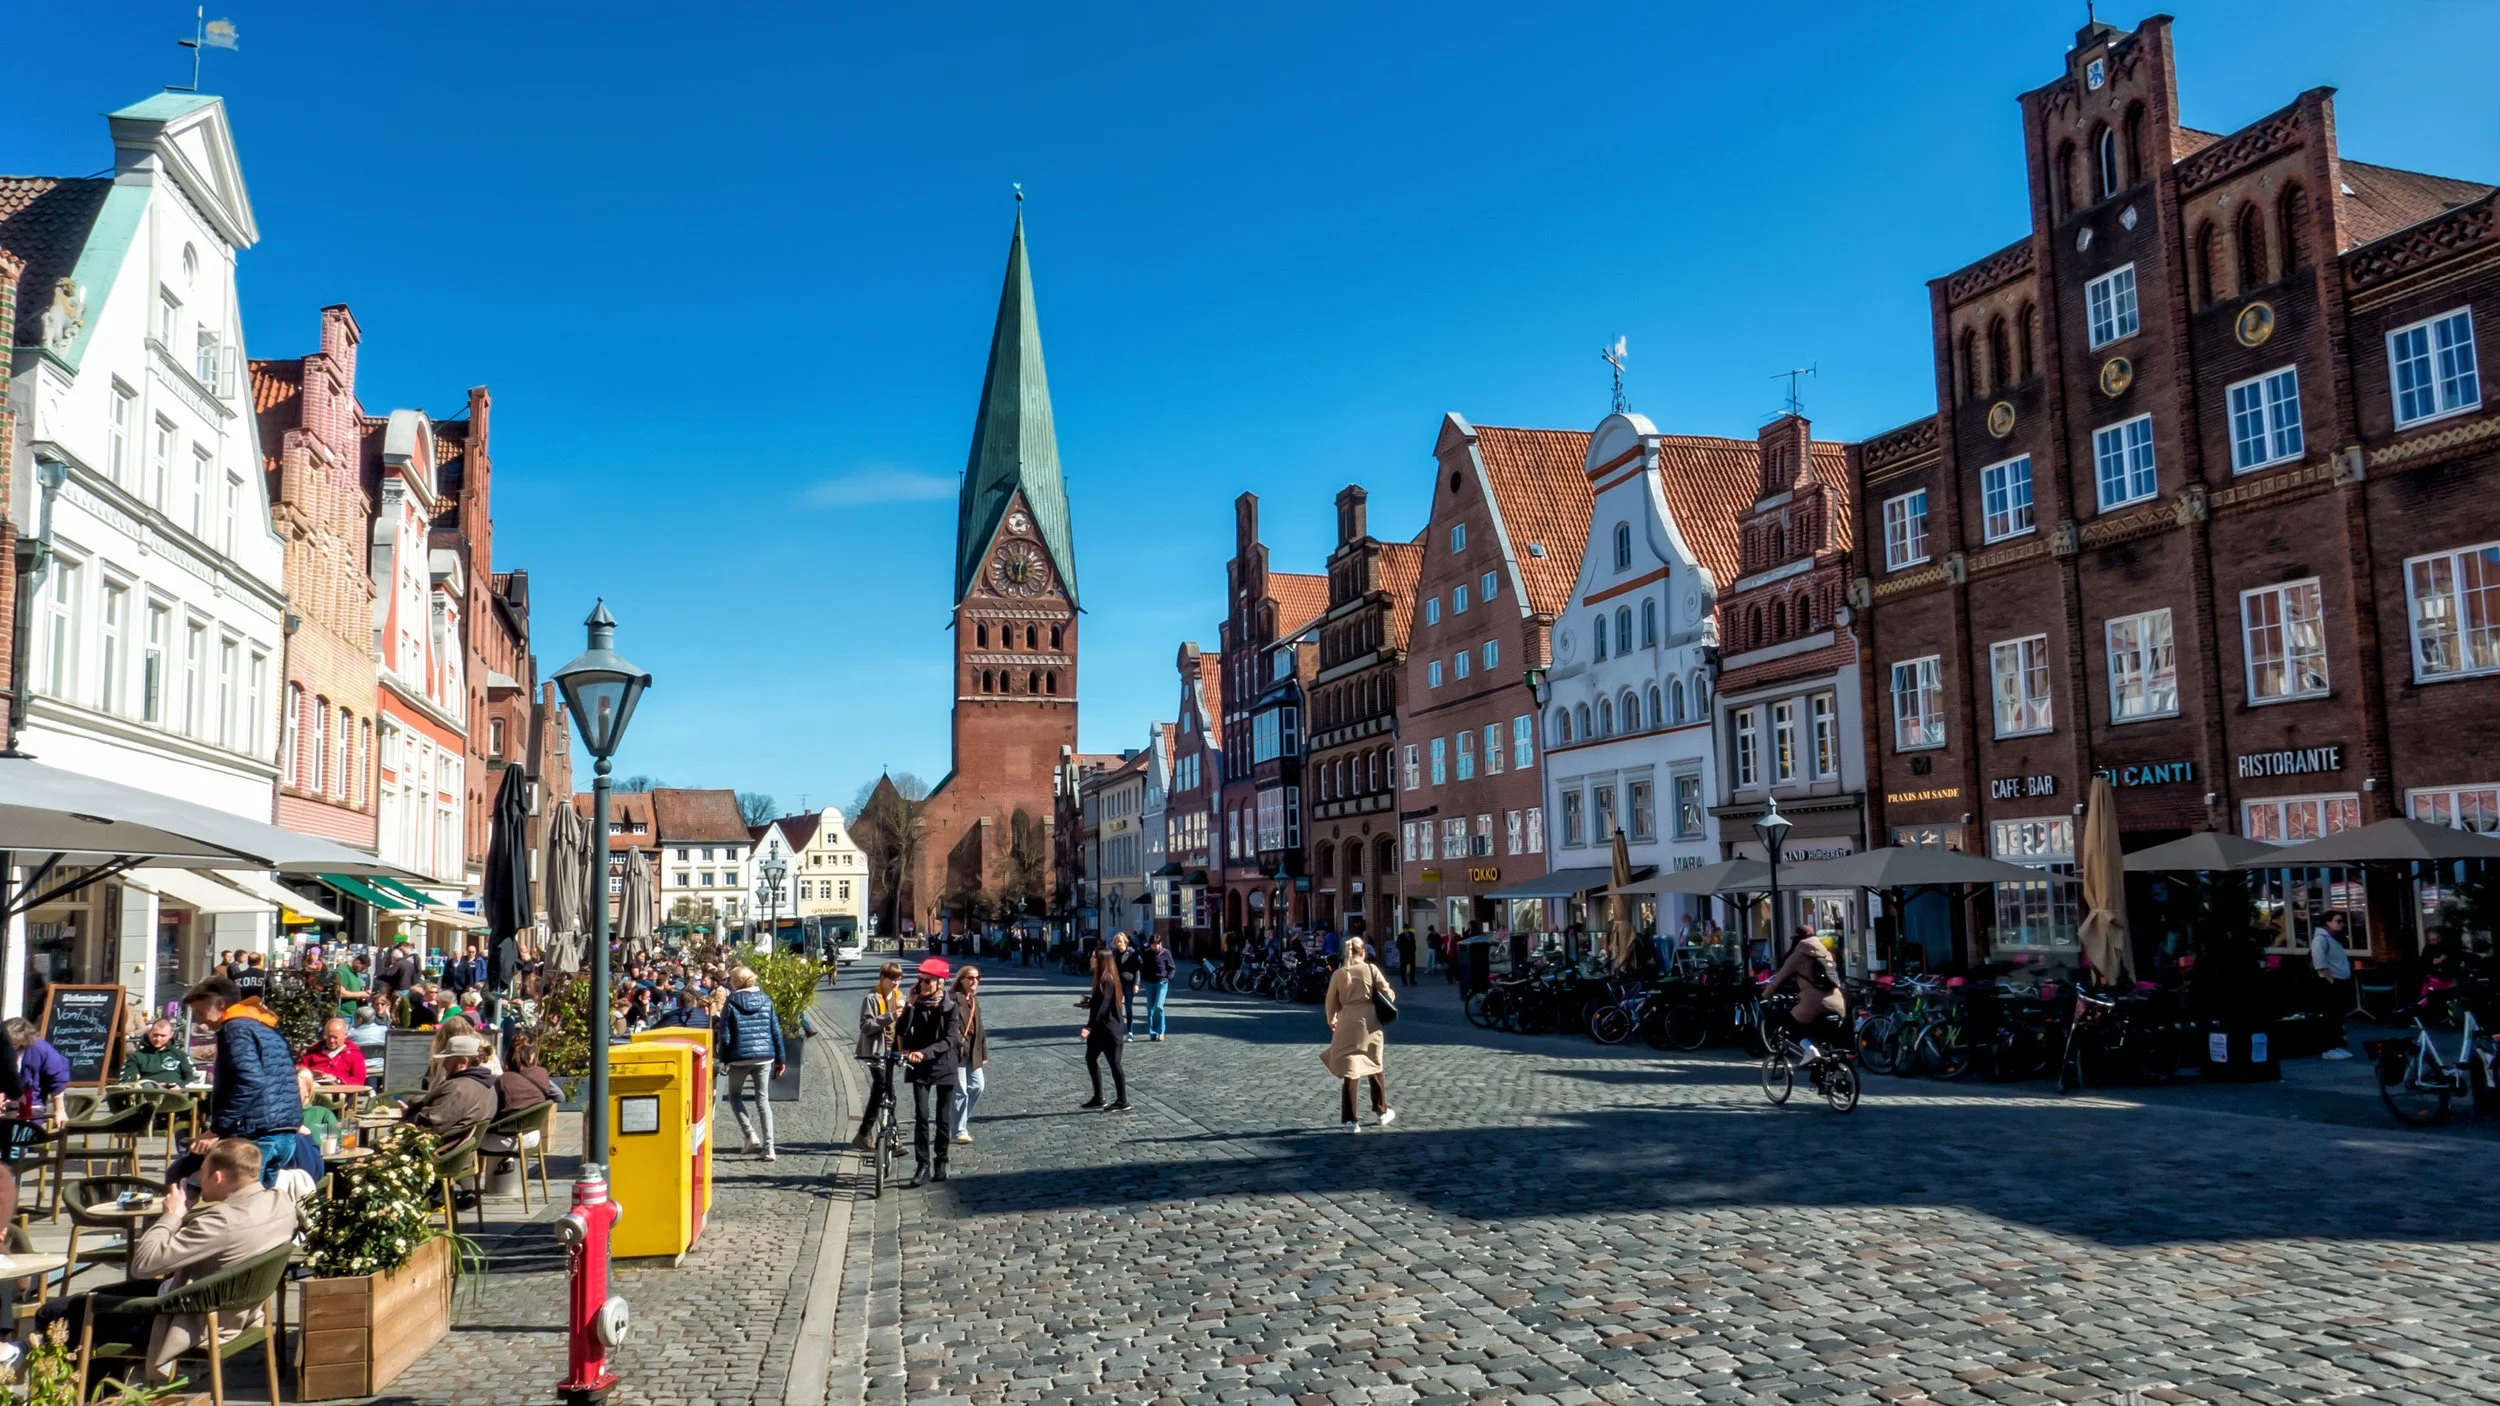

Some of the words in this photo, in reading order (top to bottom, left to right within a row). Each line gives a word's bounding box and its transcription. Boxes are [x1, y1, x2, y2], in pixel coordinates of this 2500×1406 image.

[2238, 746, 2340, 778] RISTORANTE
[1888, 790, 1917, 803] PRAXIS
[1917, 790, 1931, 801] AM
[1932, 788, 1960, 799] SANDE
[1991, 778, 2020, 799] CAFE
[2028, 775, 2053, 796] BAR
[1782, 849, 1805, 862] KIND
